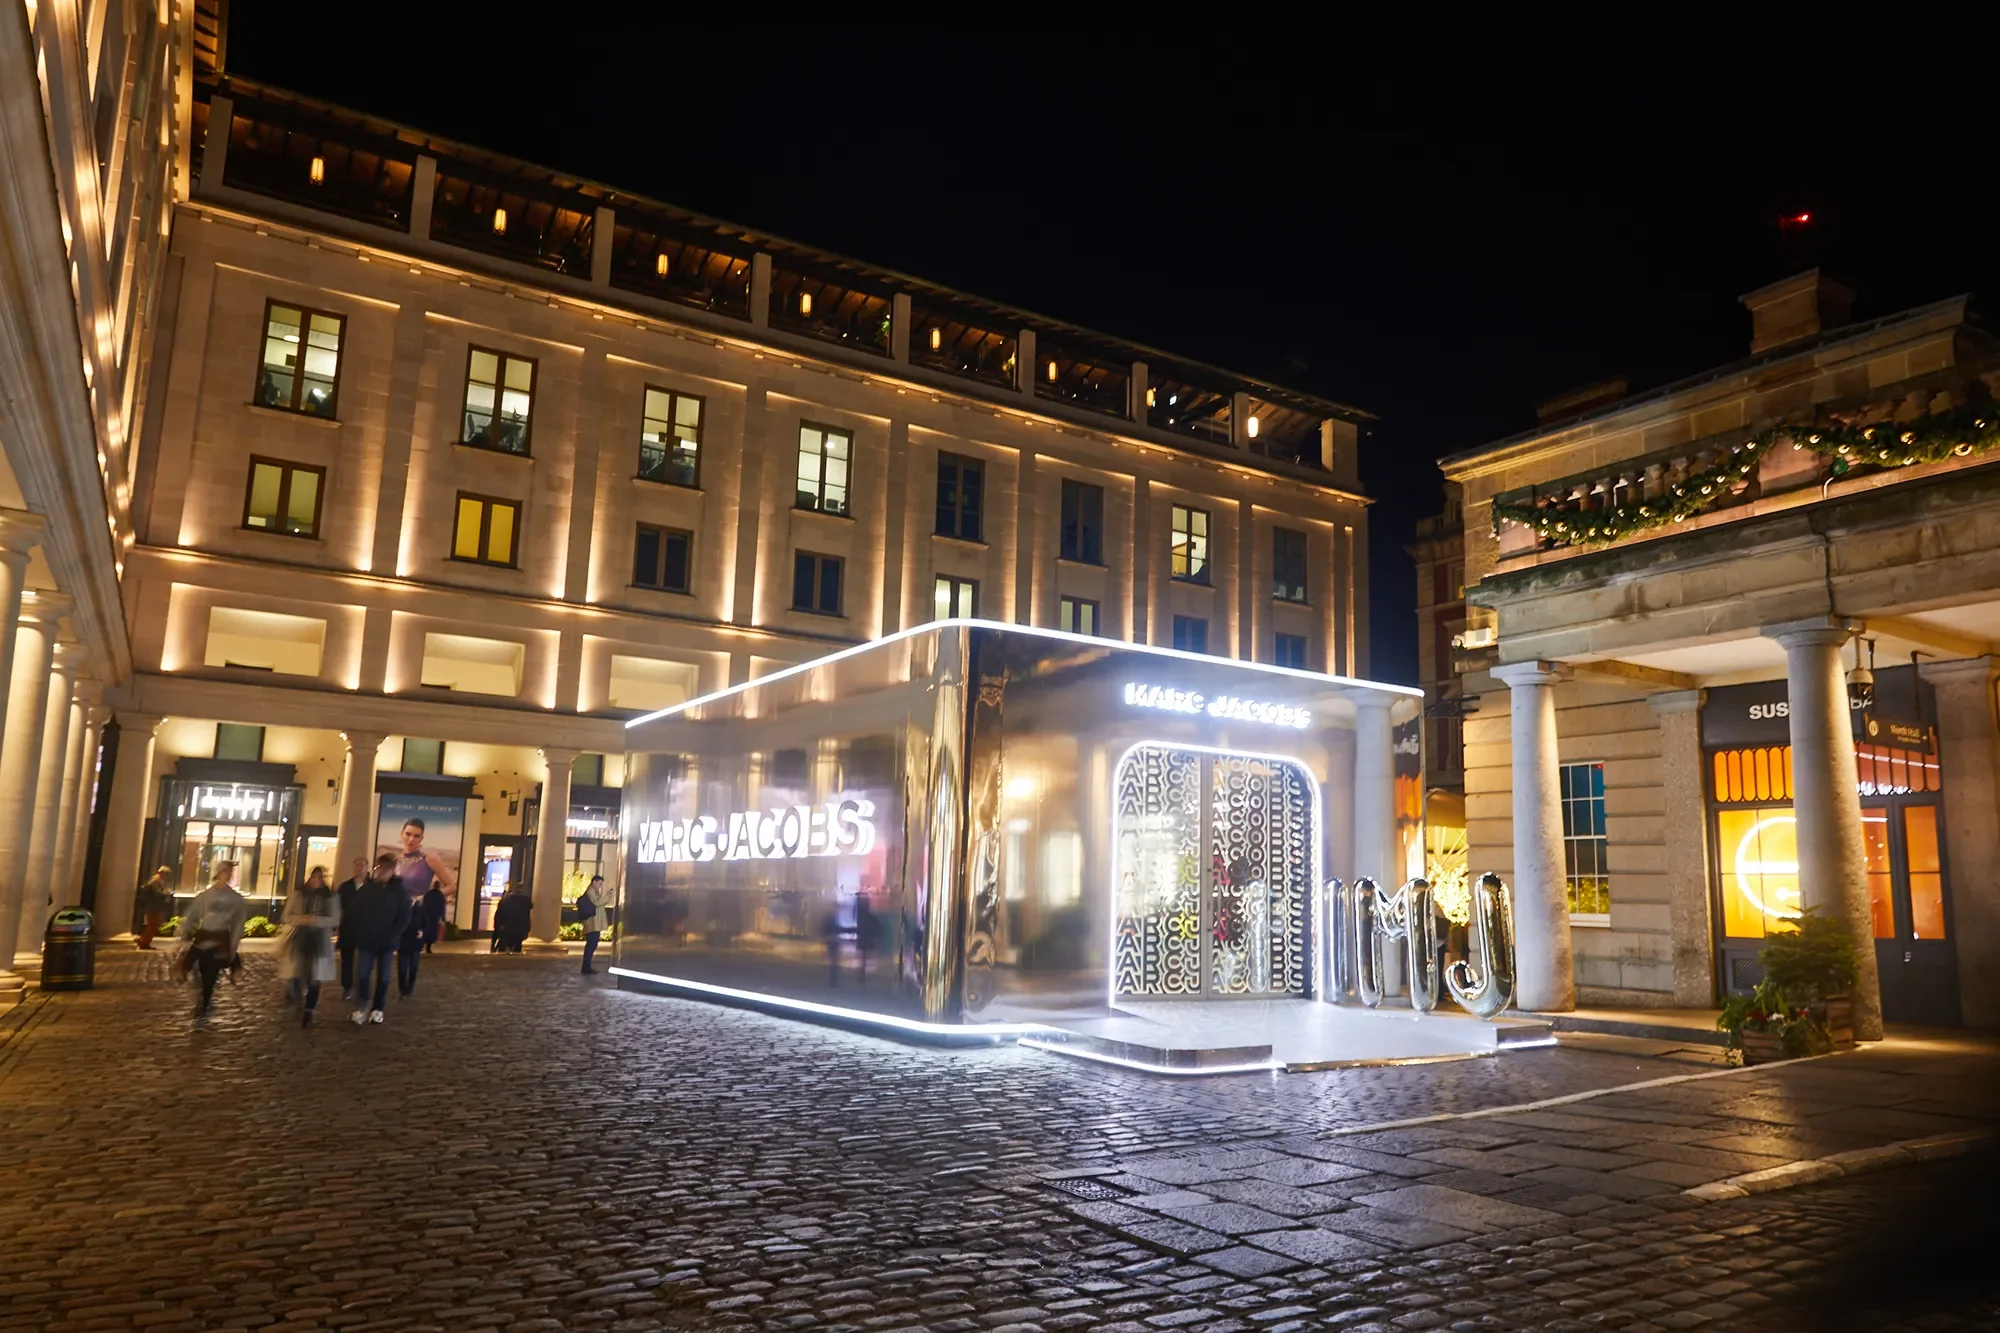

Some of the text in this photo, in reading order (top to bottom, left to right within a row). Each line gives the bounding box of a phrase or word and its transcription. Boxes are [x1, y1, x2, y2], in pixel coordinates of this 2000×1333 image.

[1124, 682, 1312, 729] MARC JACOBS
[1749, 701, 1789, 720] SUS
[637, 799, 876, 863] MARC JACOBS
